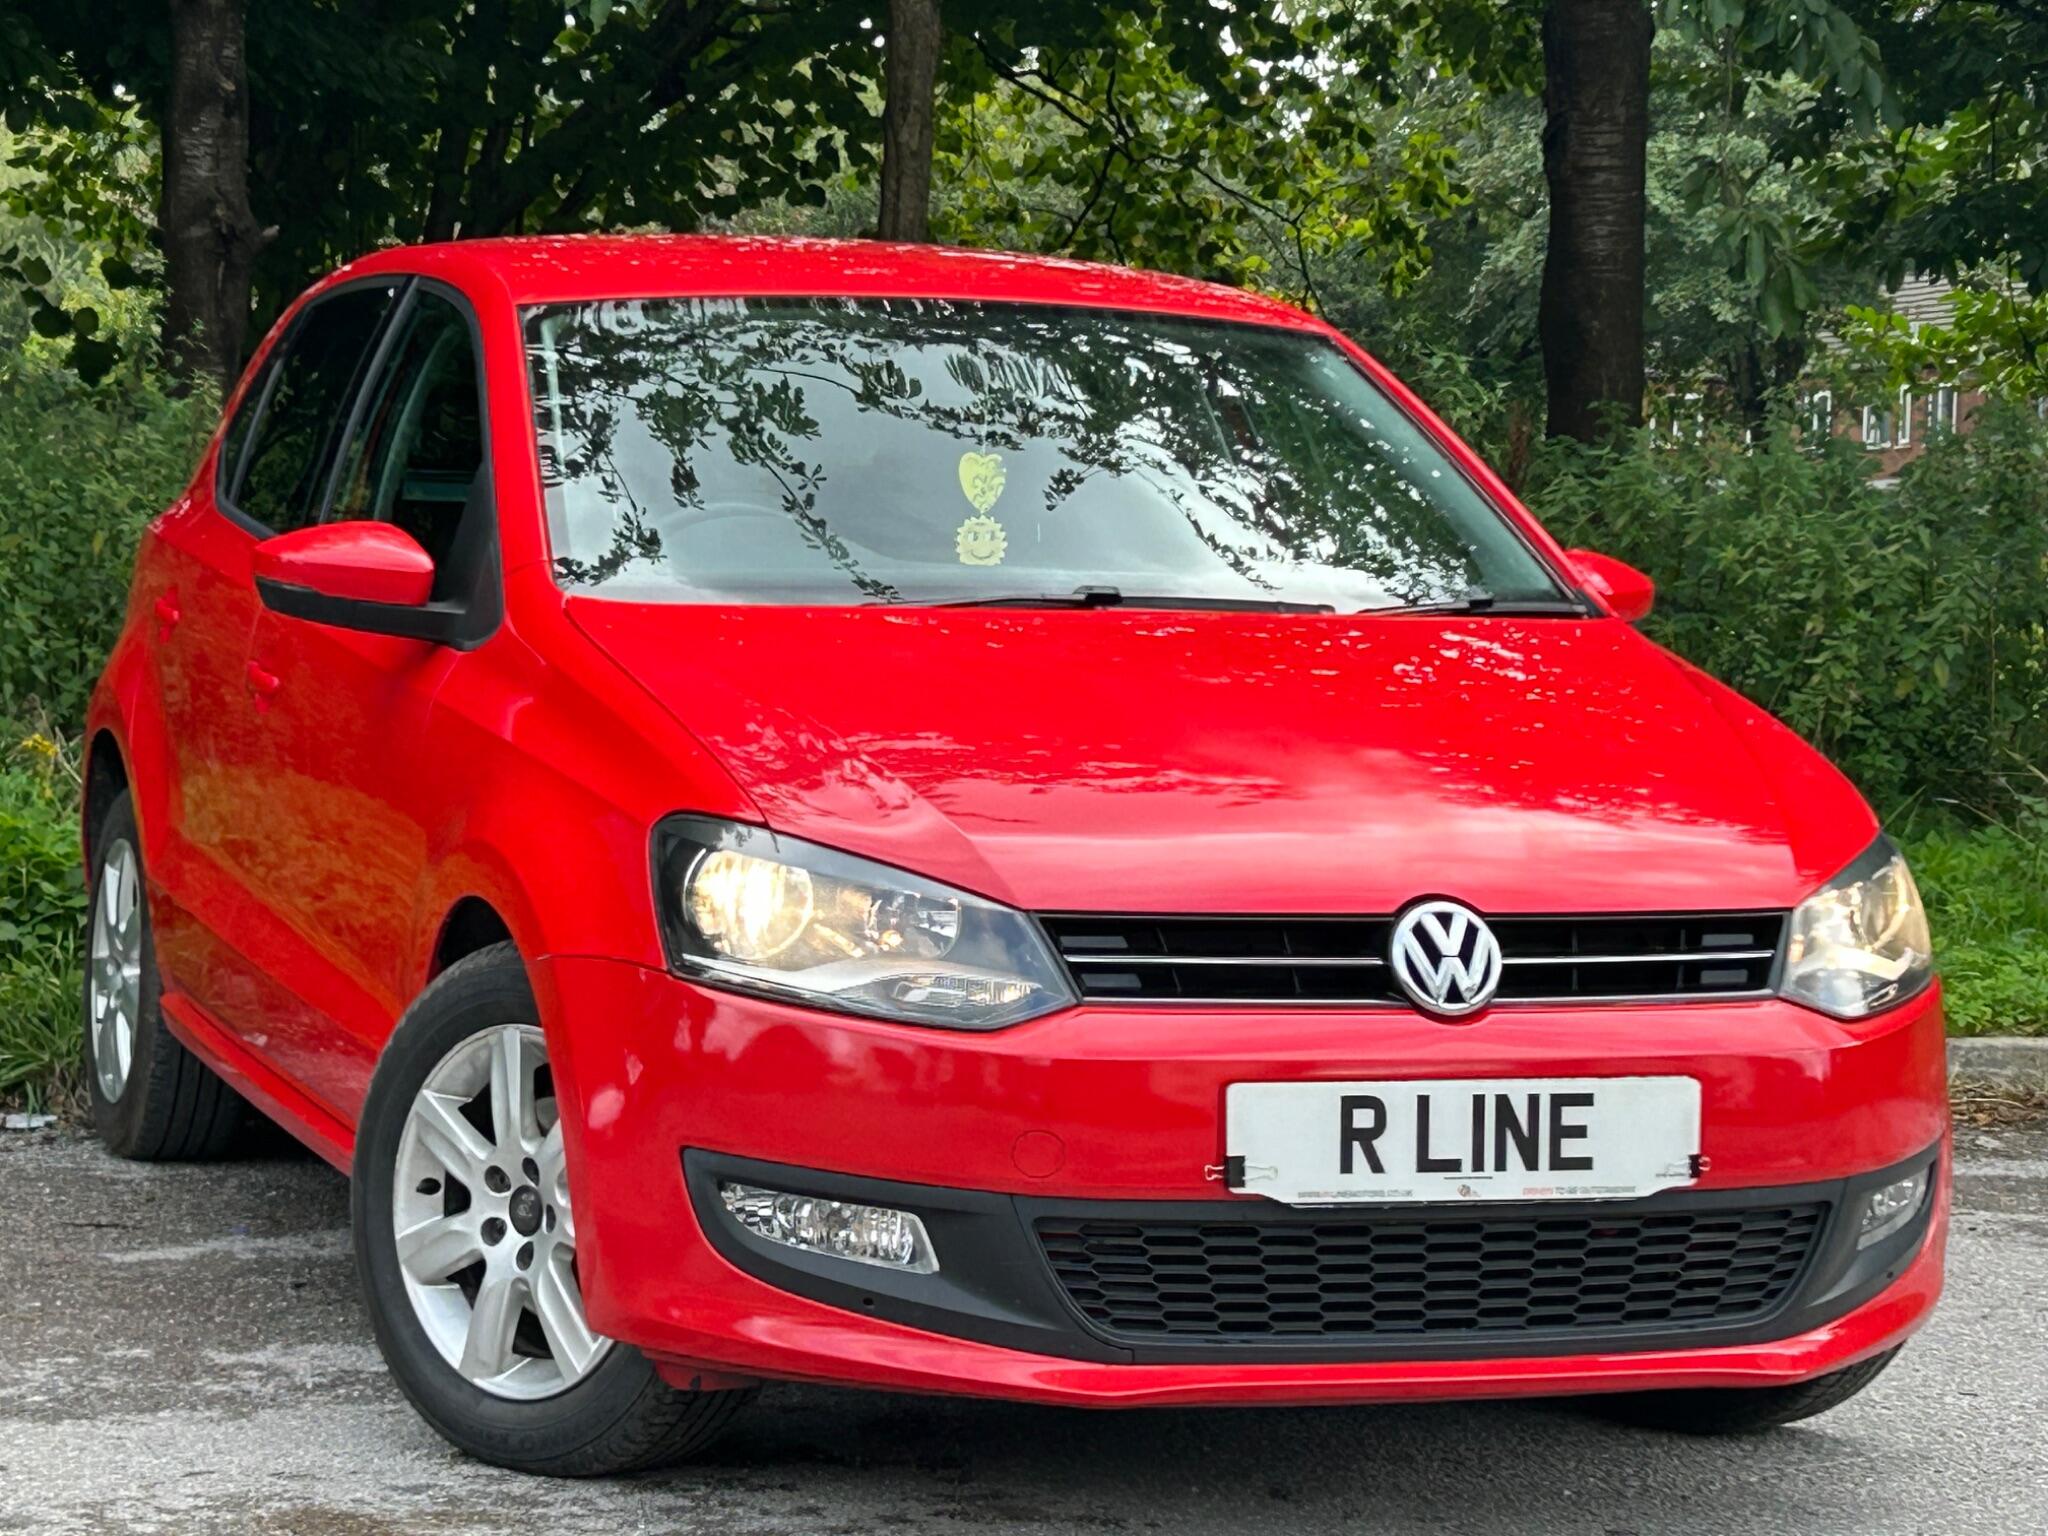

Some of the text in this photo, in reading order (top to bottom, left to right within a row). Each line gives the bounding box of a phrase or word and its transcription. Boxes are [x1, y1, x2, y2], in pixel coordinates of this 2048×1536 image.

[1399, 909, 1493, 1006] VW
[1340, 1093, 1594, 1173] R LINE
